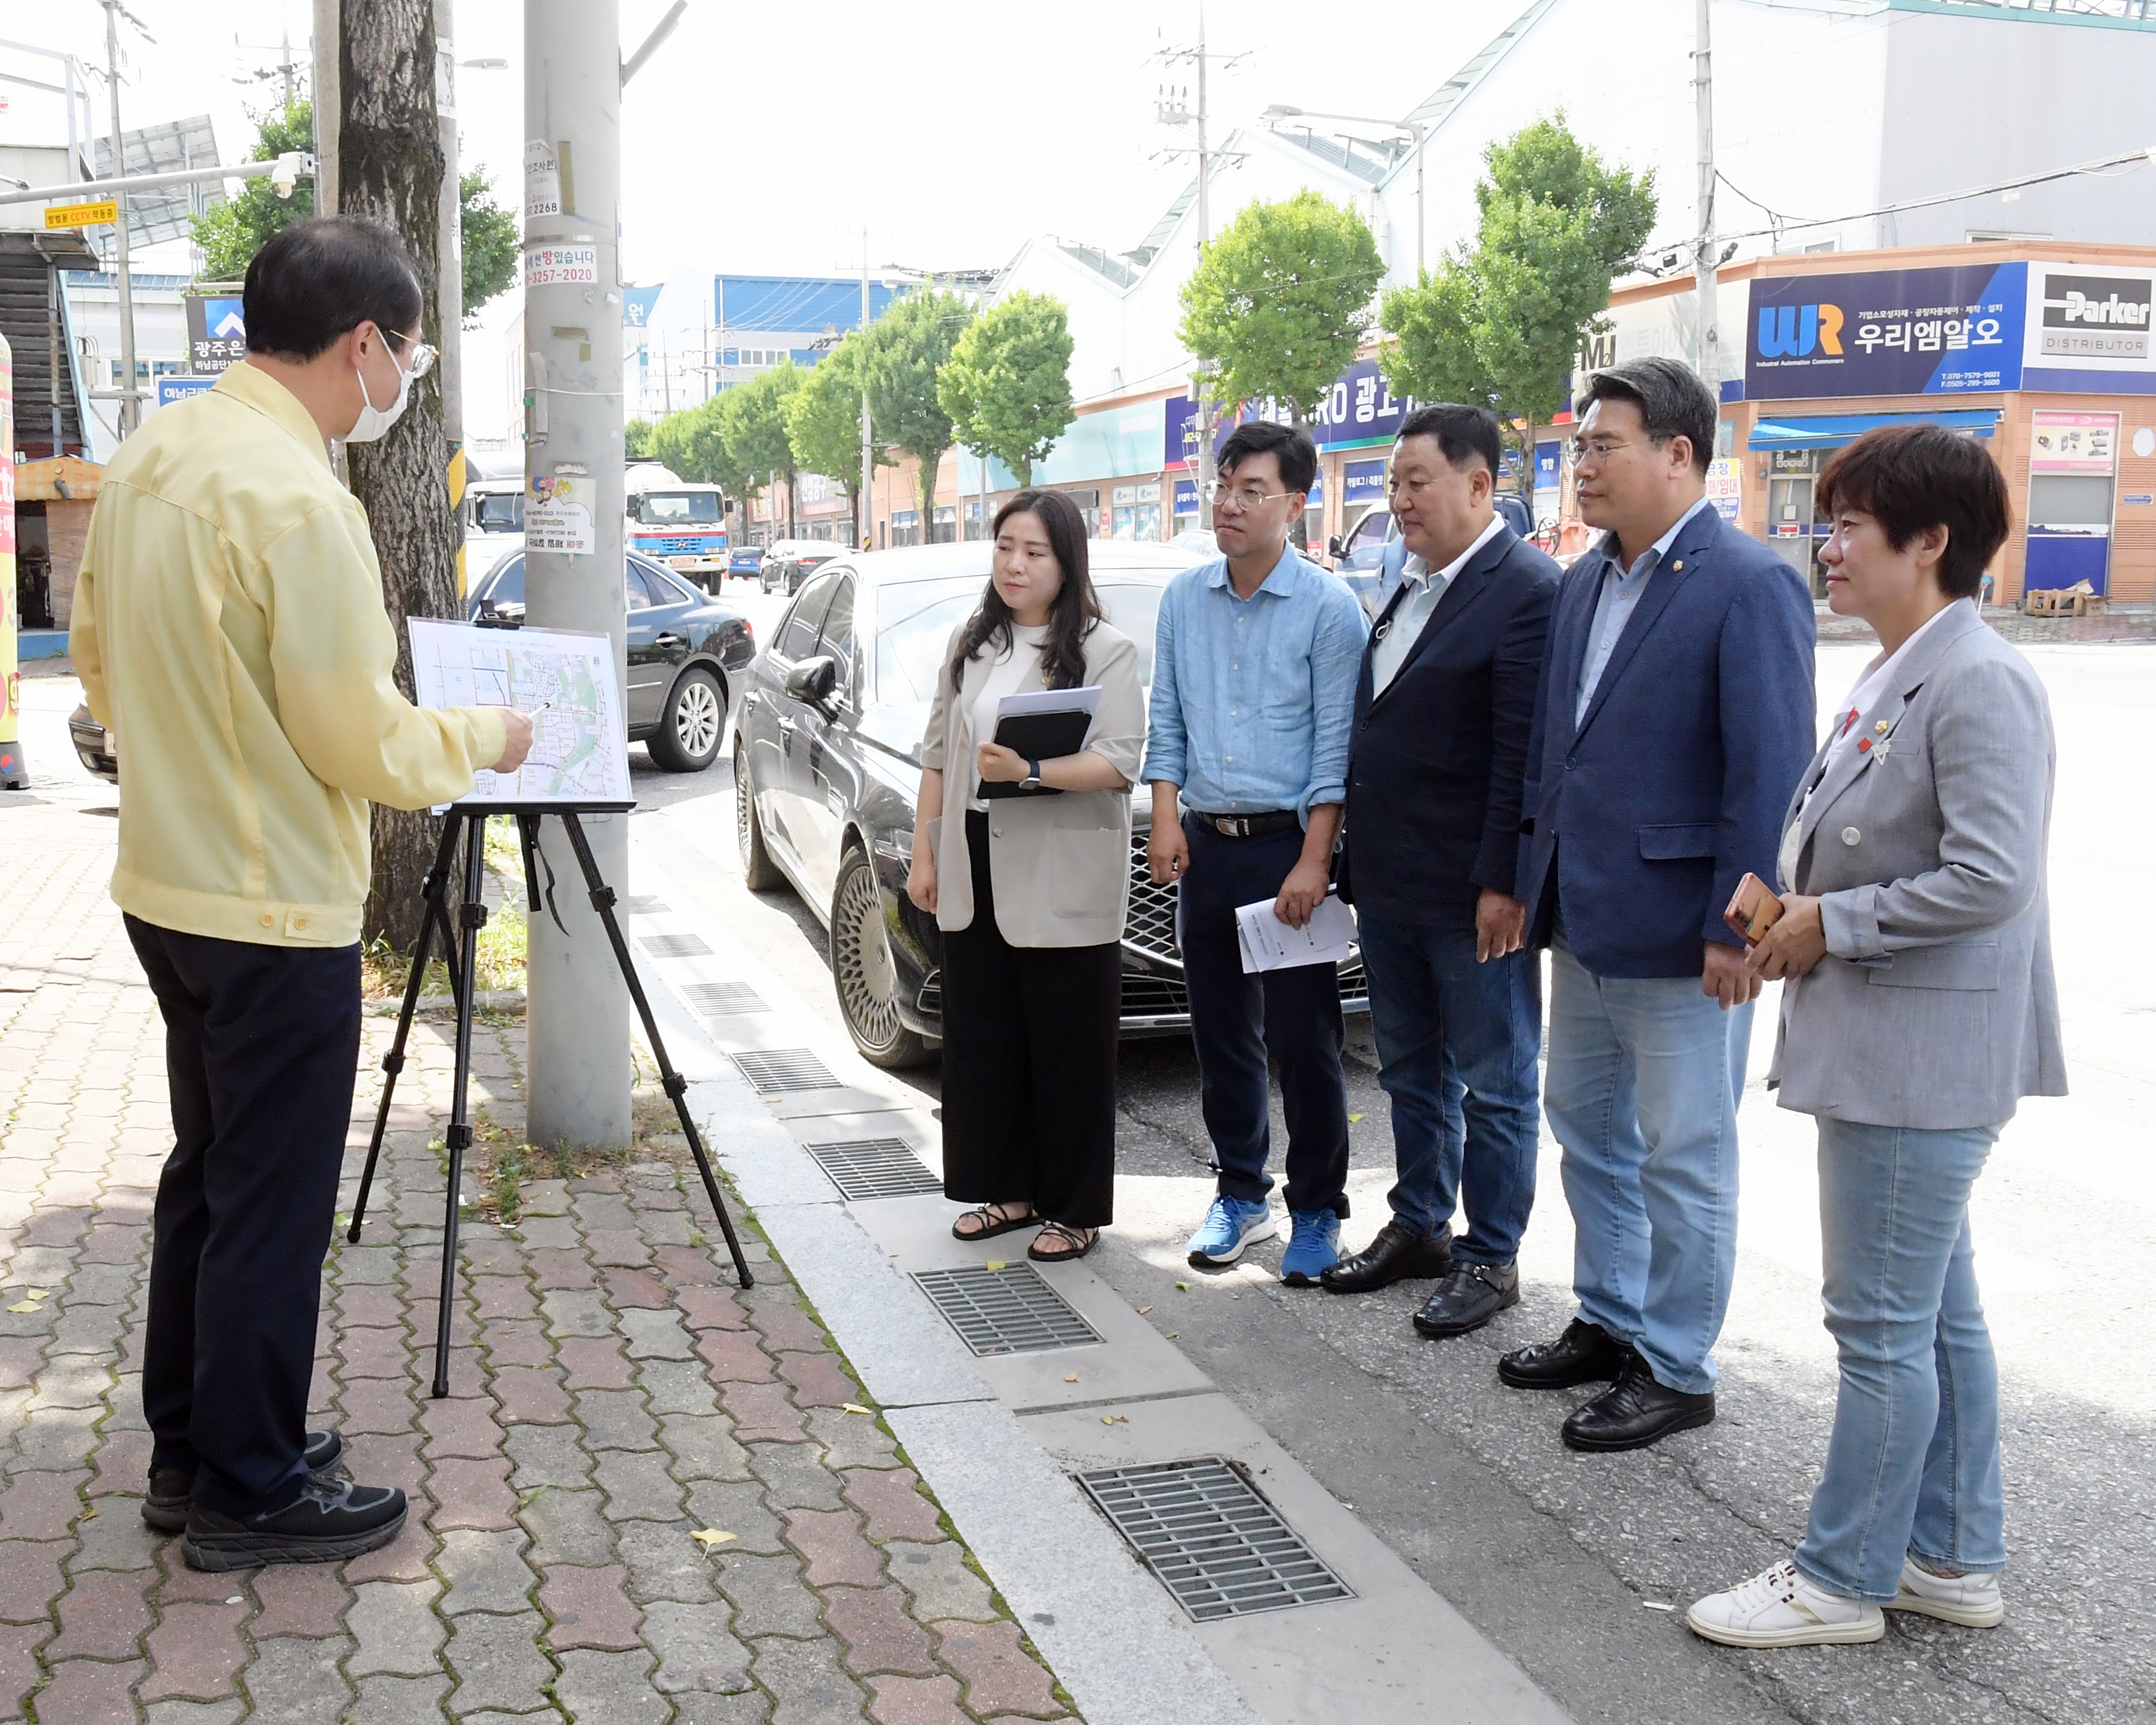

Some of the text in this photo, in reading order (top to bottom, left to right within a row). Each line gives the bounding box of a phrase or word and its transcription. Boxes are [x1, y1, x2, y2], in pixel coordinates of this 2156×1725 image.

[48, 208, 112, 224] 방범용 CCTV 작동중
[1858, 304, 2003, 320] 기업소모성자재 공장자동제어 제작 설치
[2064, 290, 2150, 325] Parker
[1854, 318, 2003, 354] 우리엠알오
[2046, 338, 2144, 350] DISTRIBUTOR
[194, 340, 246, 358] 광주은
[1301, 382, 1348, 426] RO
[1541, 458, 1555, 470] 명함
[1347, 477, 1365, 488] 카탈로그
[1705, 477, 1738, 496] 매/임대
